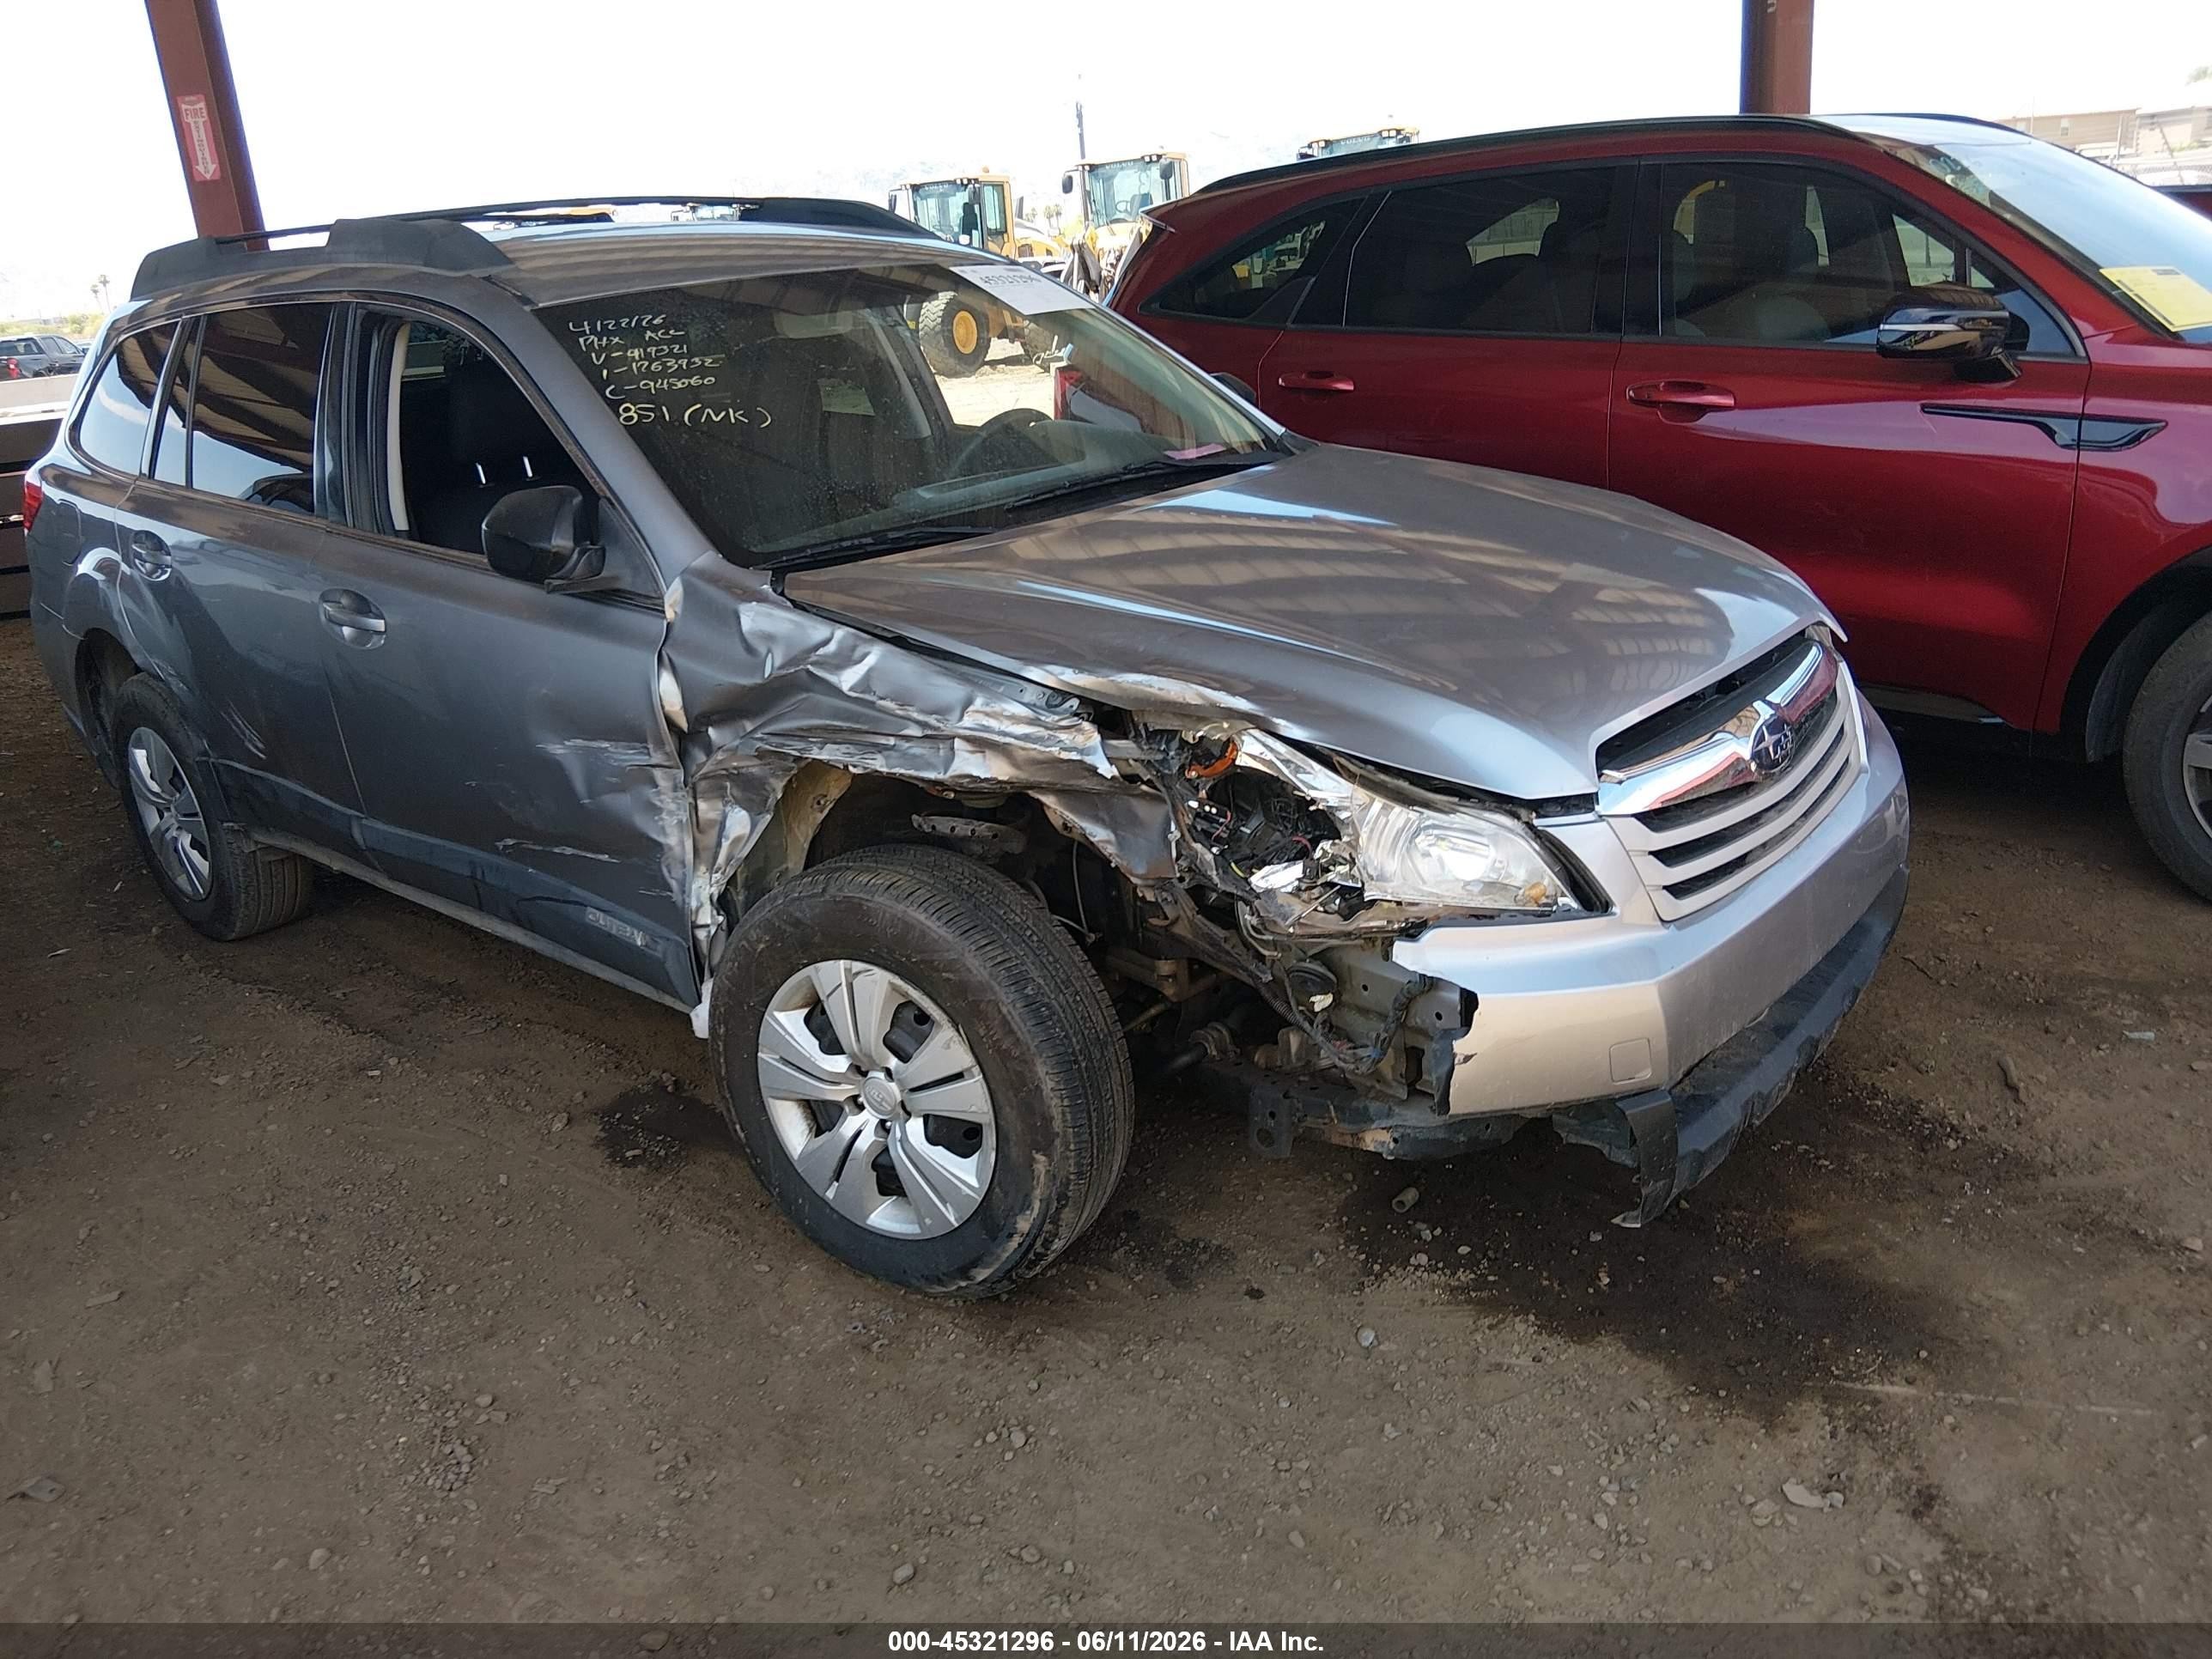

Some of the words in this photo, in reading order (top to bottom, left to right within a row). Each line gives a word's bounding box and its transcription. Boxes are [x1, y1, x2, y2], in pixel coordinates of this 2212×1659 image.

[184, 107, 206, 120] FIRE
[579, 335, 625, 351] PHX
[618, 403, 671, 425] 851
[588, 911, 654, 948] OUTBA
